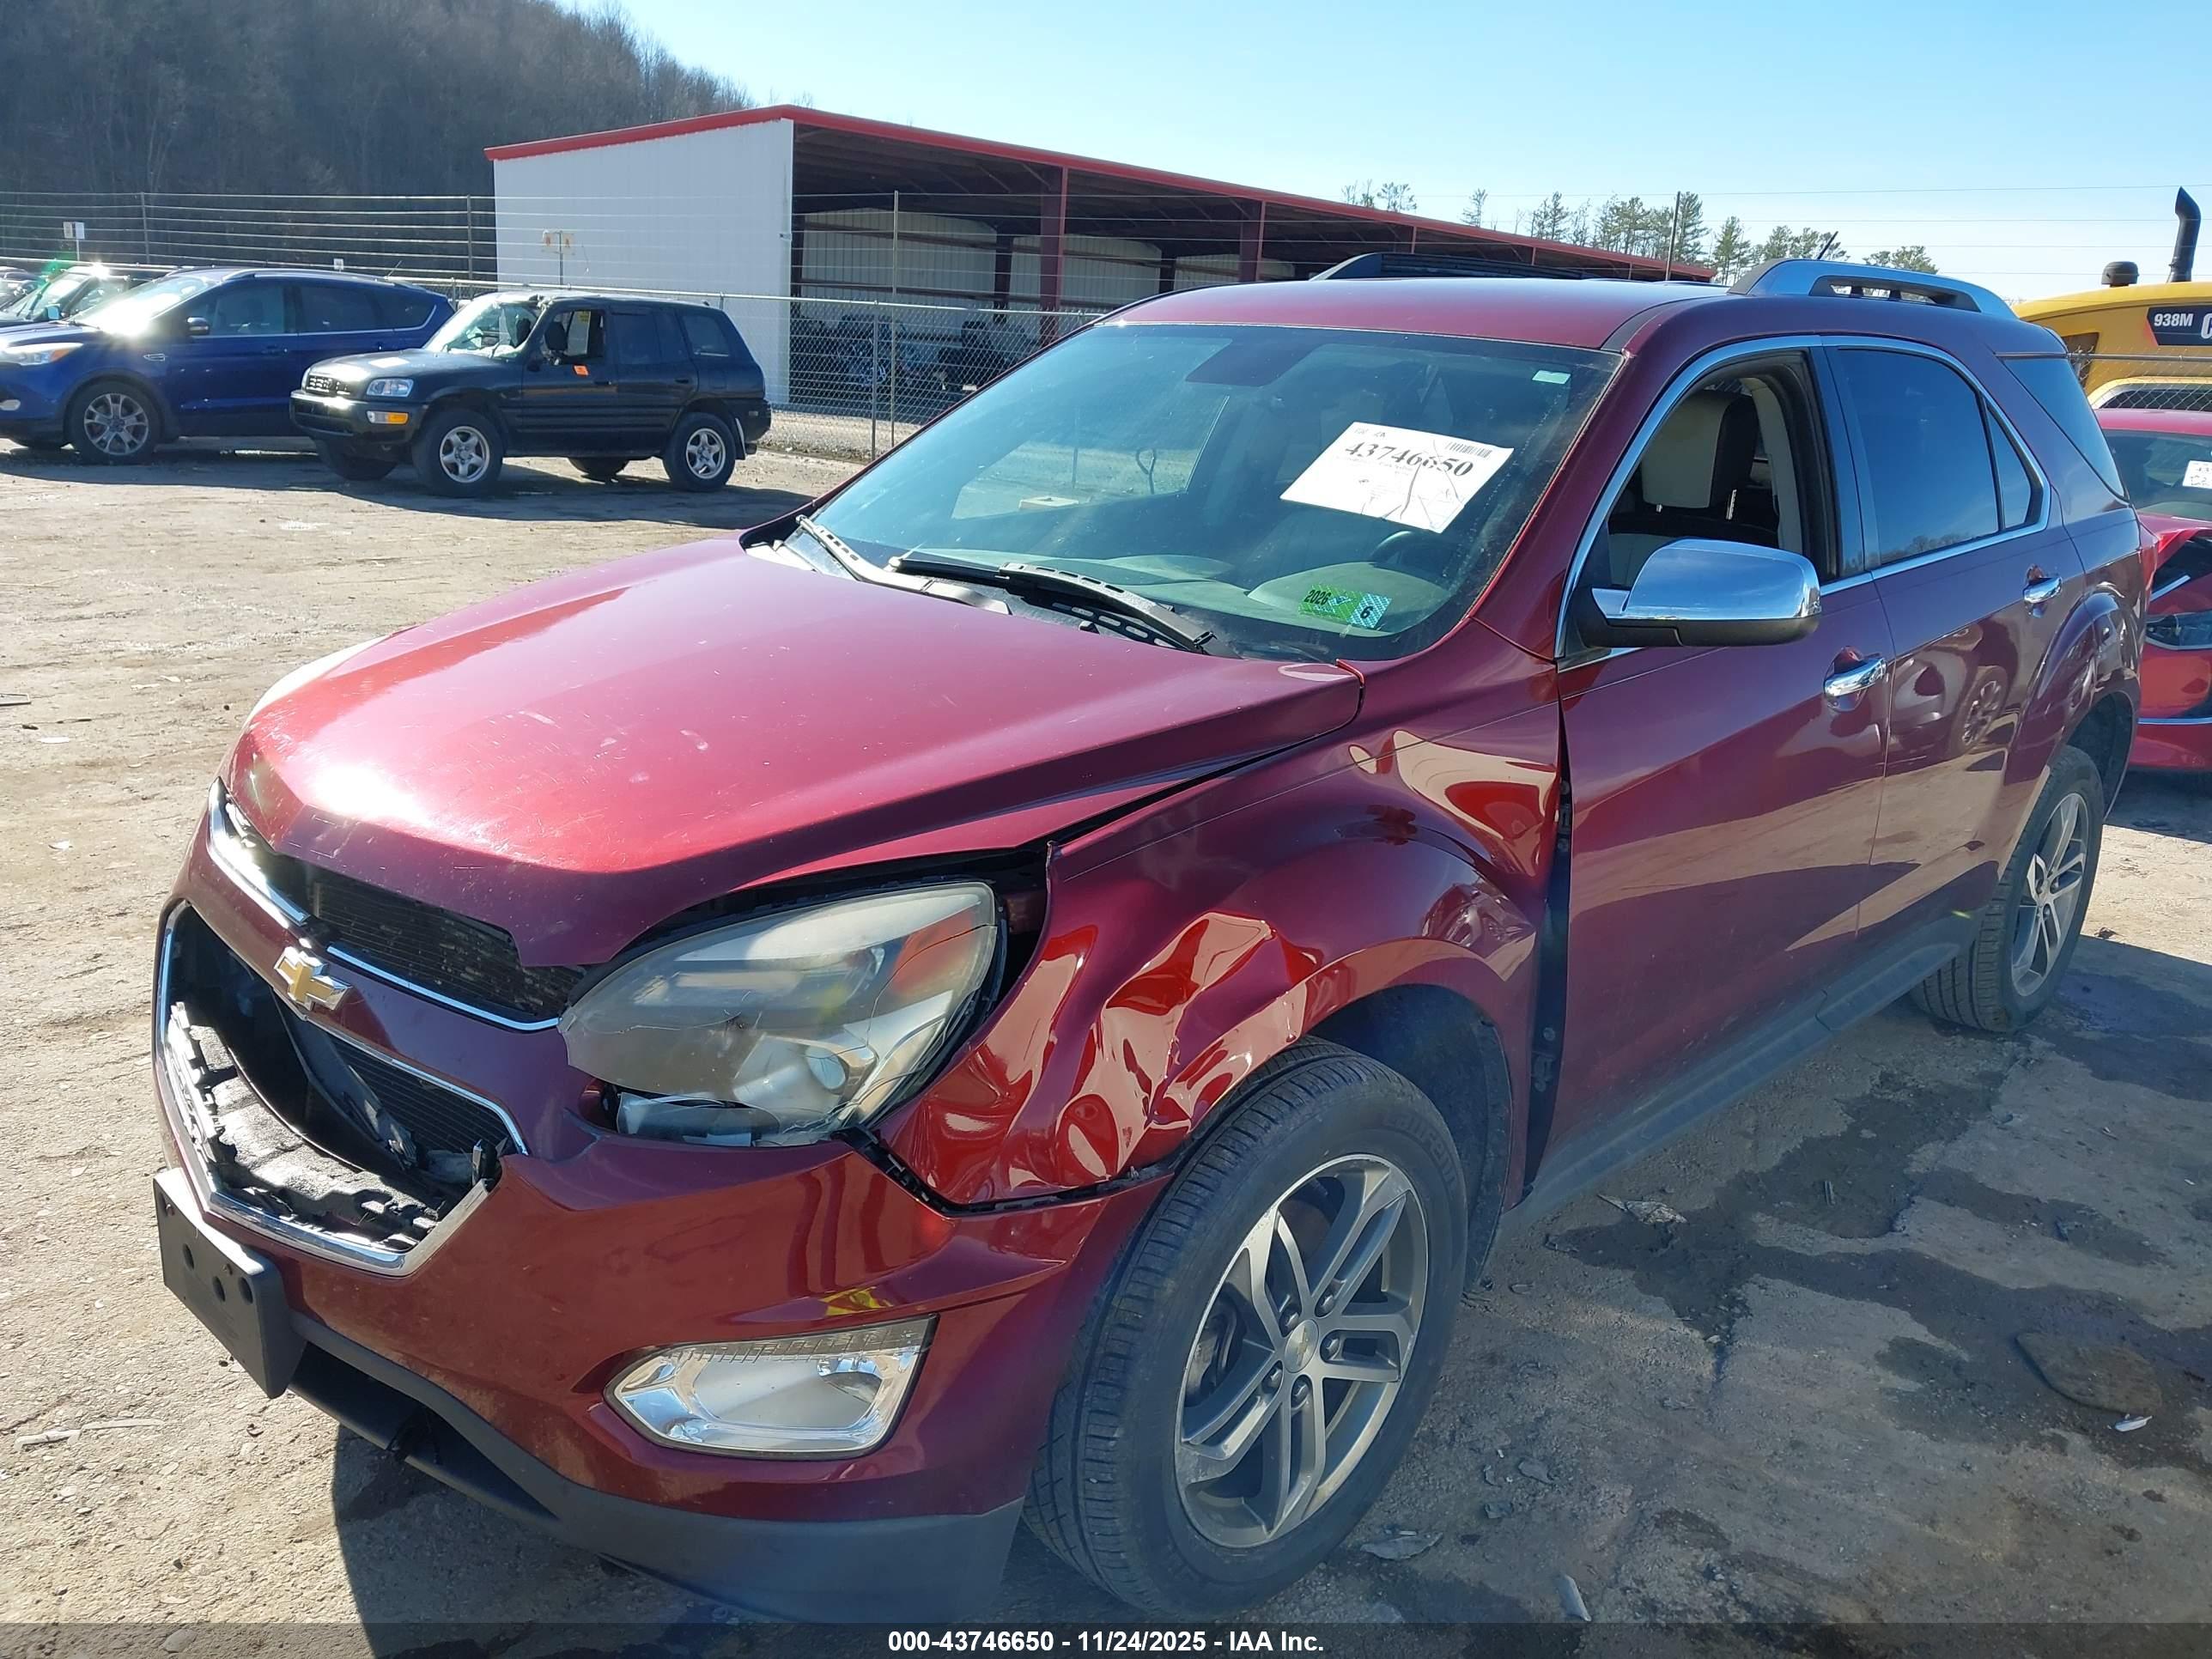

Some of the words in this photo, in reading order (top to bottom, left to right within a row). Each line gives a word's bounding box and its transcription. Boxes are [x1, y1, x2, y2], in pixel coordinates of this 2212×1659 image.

[2154, 313, 2194, 326] 938M
[1345, 441, 1474, 477] 43746650
[1304, 589, 1332, 605] 2026
[1360, 605, 1375, 619] 6
